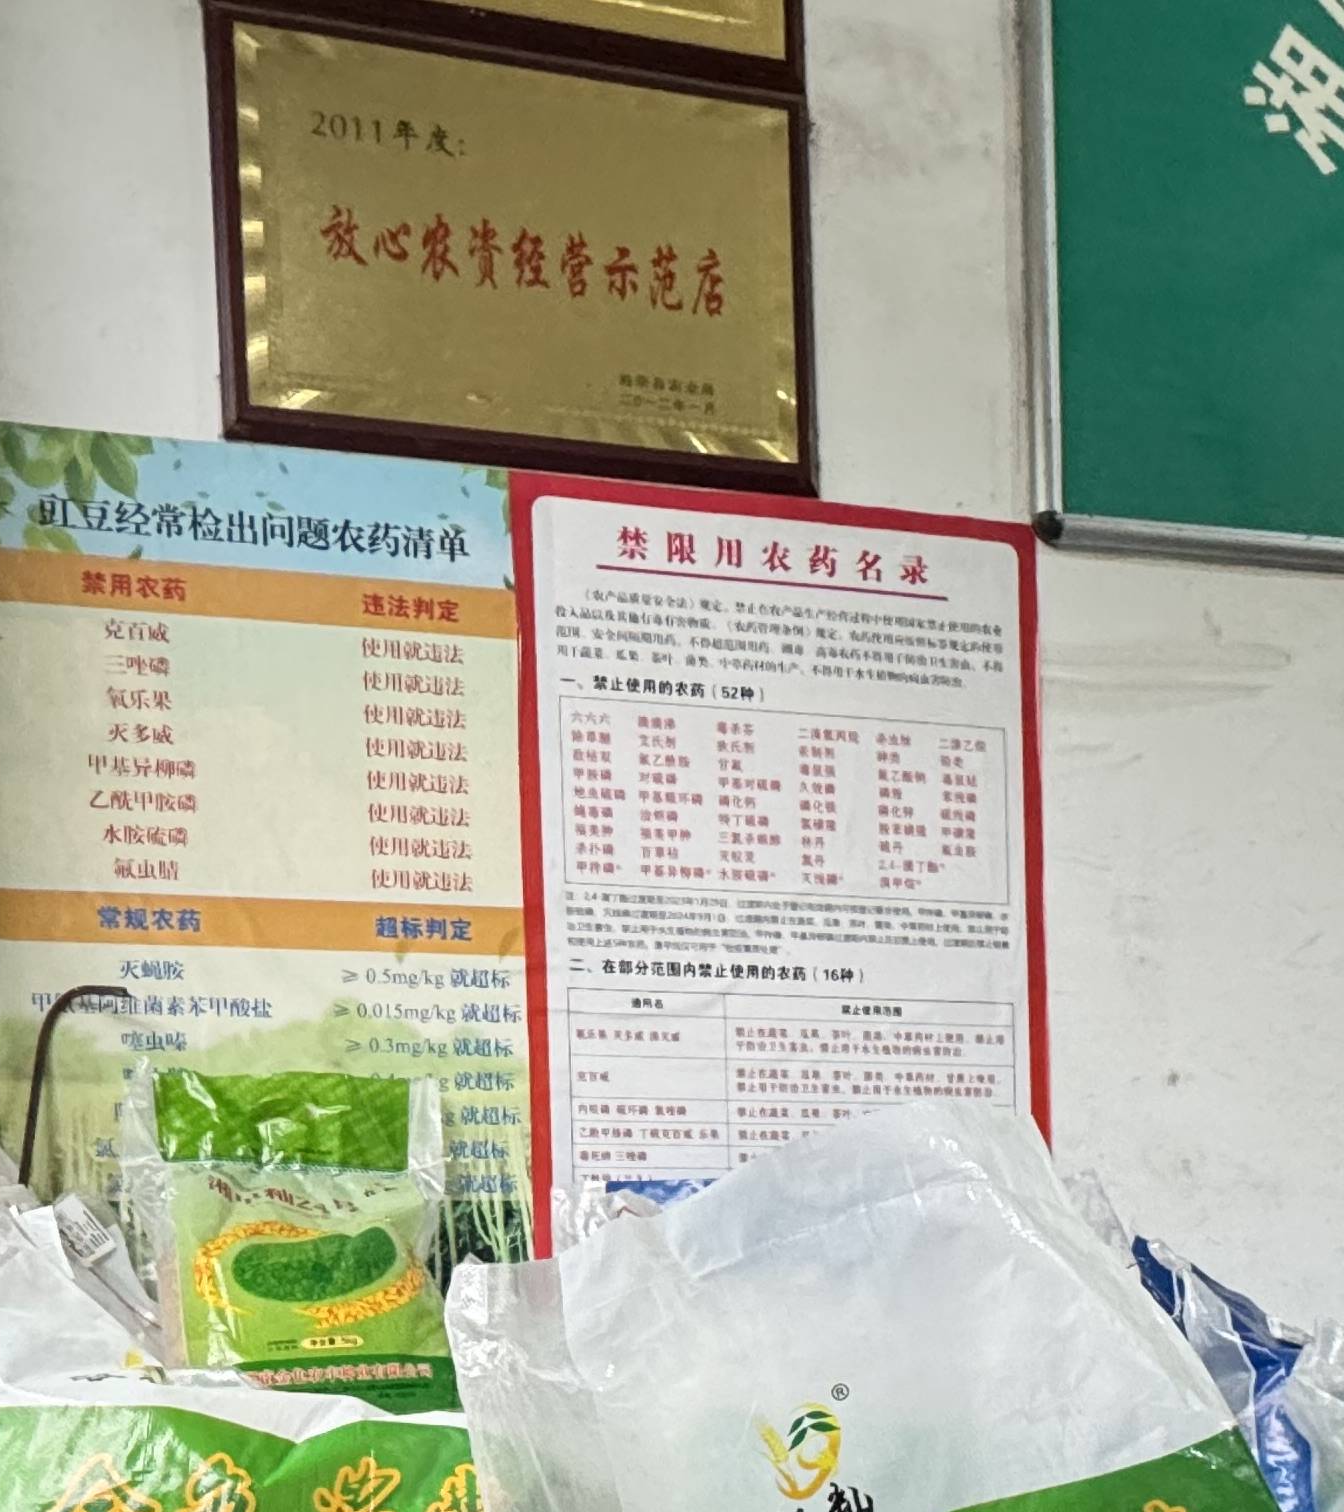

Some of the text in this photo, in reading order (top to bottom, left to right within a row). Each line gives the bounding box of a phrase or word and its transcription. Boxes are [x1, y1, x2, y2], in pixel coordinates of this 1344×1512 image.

[38, 493, 470, 563] 豇豆经常检出问题农药清单
[617, 526, 930, 585] 禁限用农药名录
[81, 570, 460, 623] 禁用农药 违法判定
[104, 617, 464, 666] 克百威 使用就违法
[363, 670, 465, 698] 使用就违法
[364, 702, 467, 730] 使用就违法
[108, 722, 468, 763] 灭多威 使用就违法
[366, 769, 470, 796] 使用就违法
[368, 802, 471, 829] 使用就违法
[370, 834, 472, 862] 使用就违法
[371, 867, 474, 894] 使用就违法
[97, 906, 472, 942] 常规农药 超标判定
[120, 959, 185, 981] 灭蝇胺
[366, 968, 444, 989] 0.5mg/kg
[450, 967, 511, 989] 就超标
[357, 1002, 456, 1024] 0.015mg/kg
[462, 1002, 523, 1024] 就超标
[369, 1037, 447, 1058] 0.3mg/kg
[453, 1037, 514, 1058] 就超标
[455, 1070, 515, 1092] 就超标
[461, 1105, 521, 1126] 就超标
